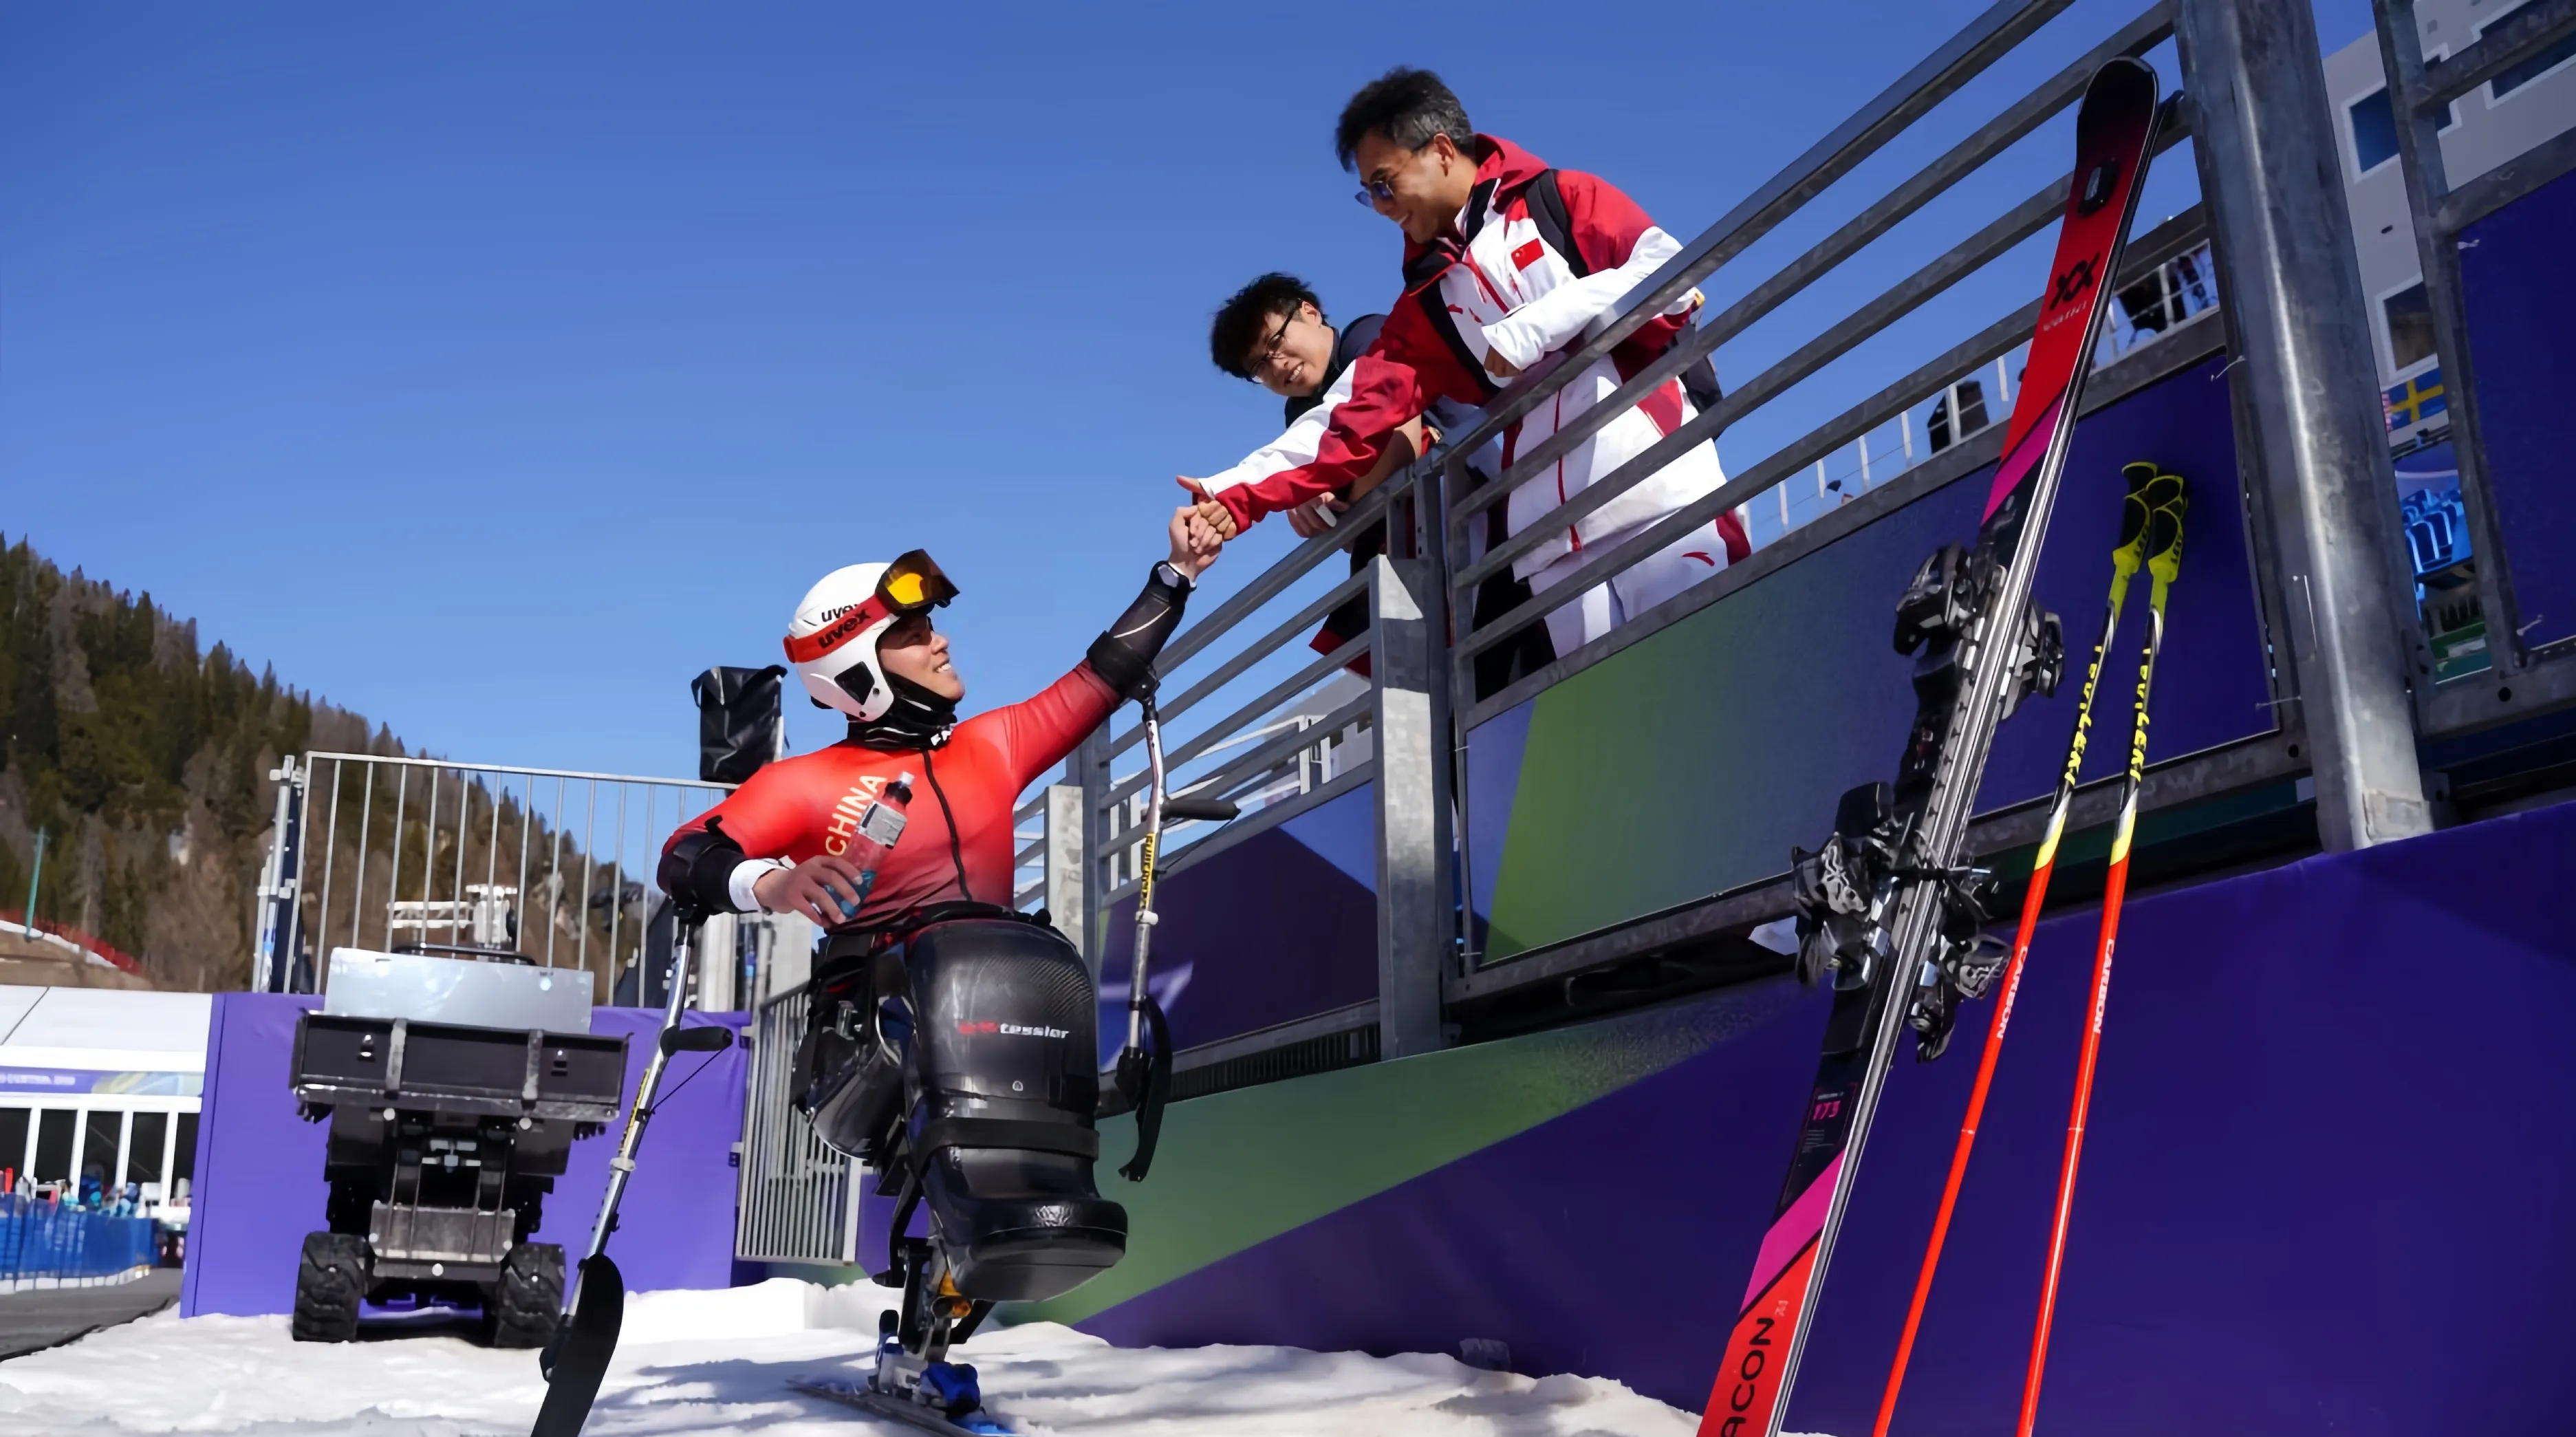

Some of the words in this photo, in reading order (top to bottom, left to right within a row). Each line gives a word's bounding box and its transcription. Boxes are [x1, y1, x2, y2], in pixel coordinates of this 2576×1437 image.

[818, 607, 871, 649] uvex
[821, 603, 858, 622] uve
[825, 775, 887, 856] CHINA
